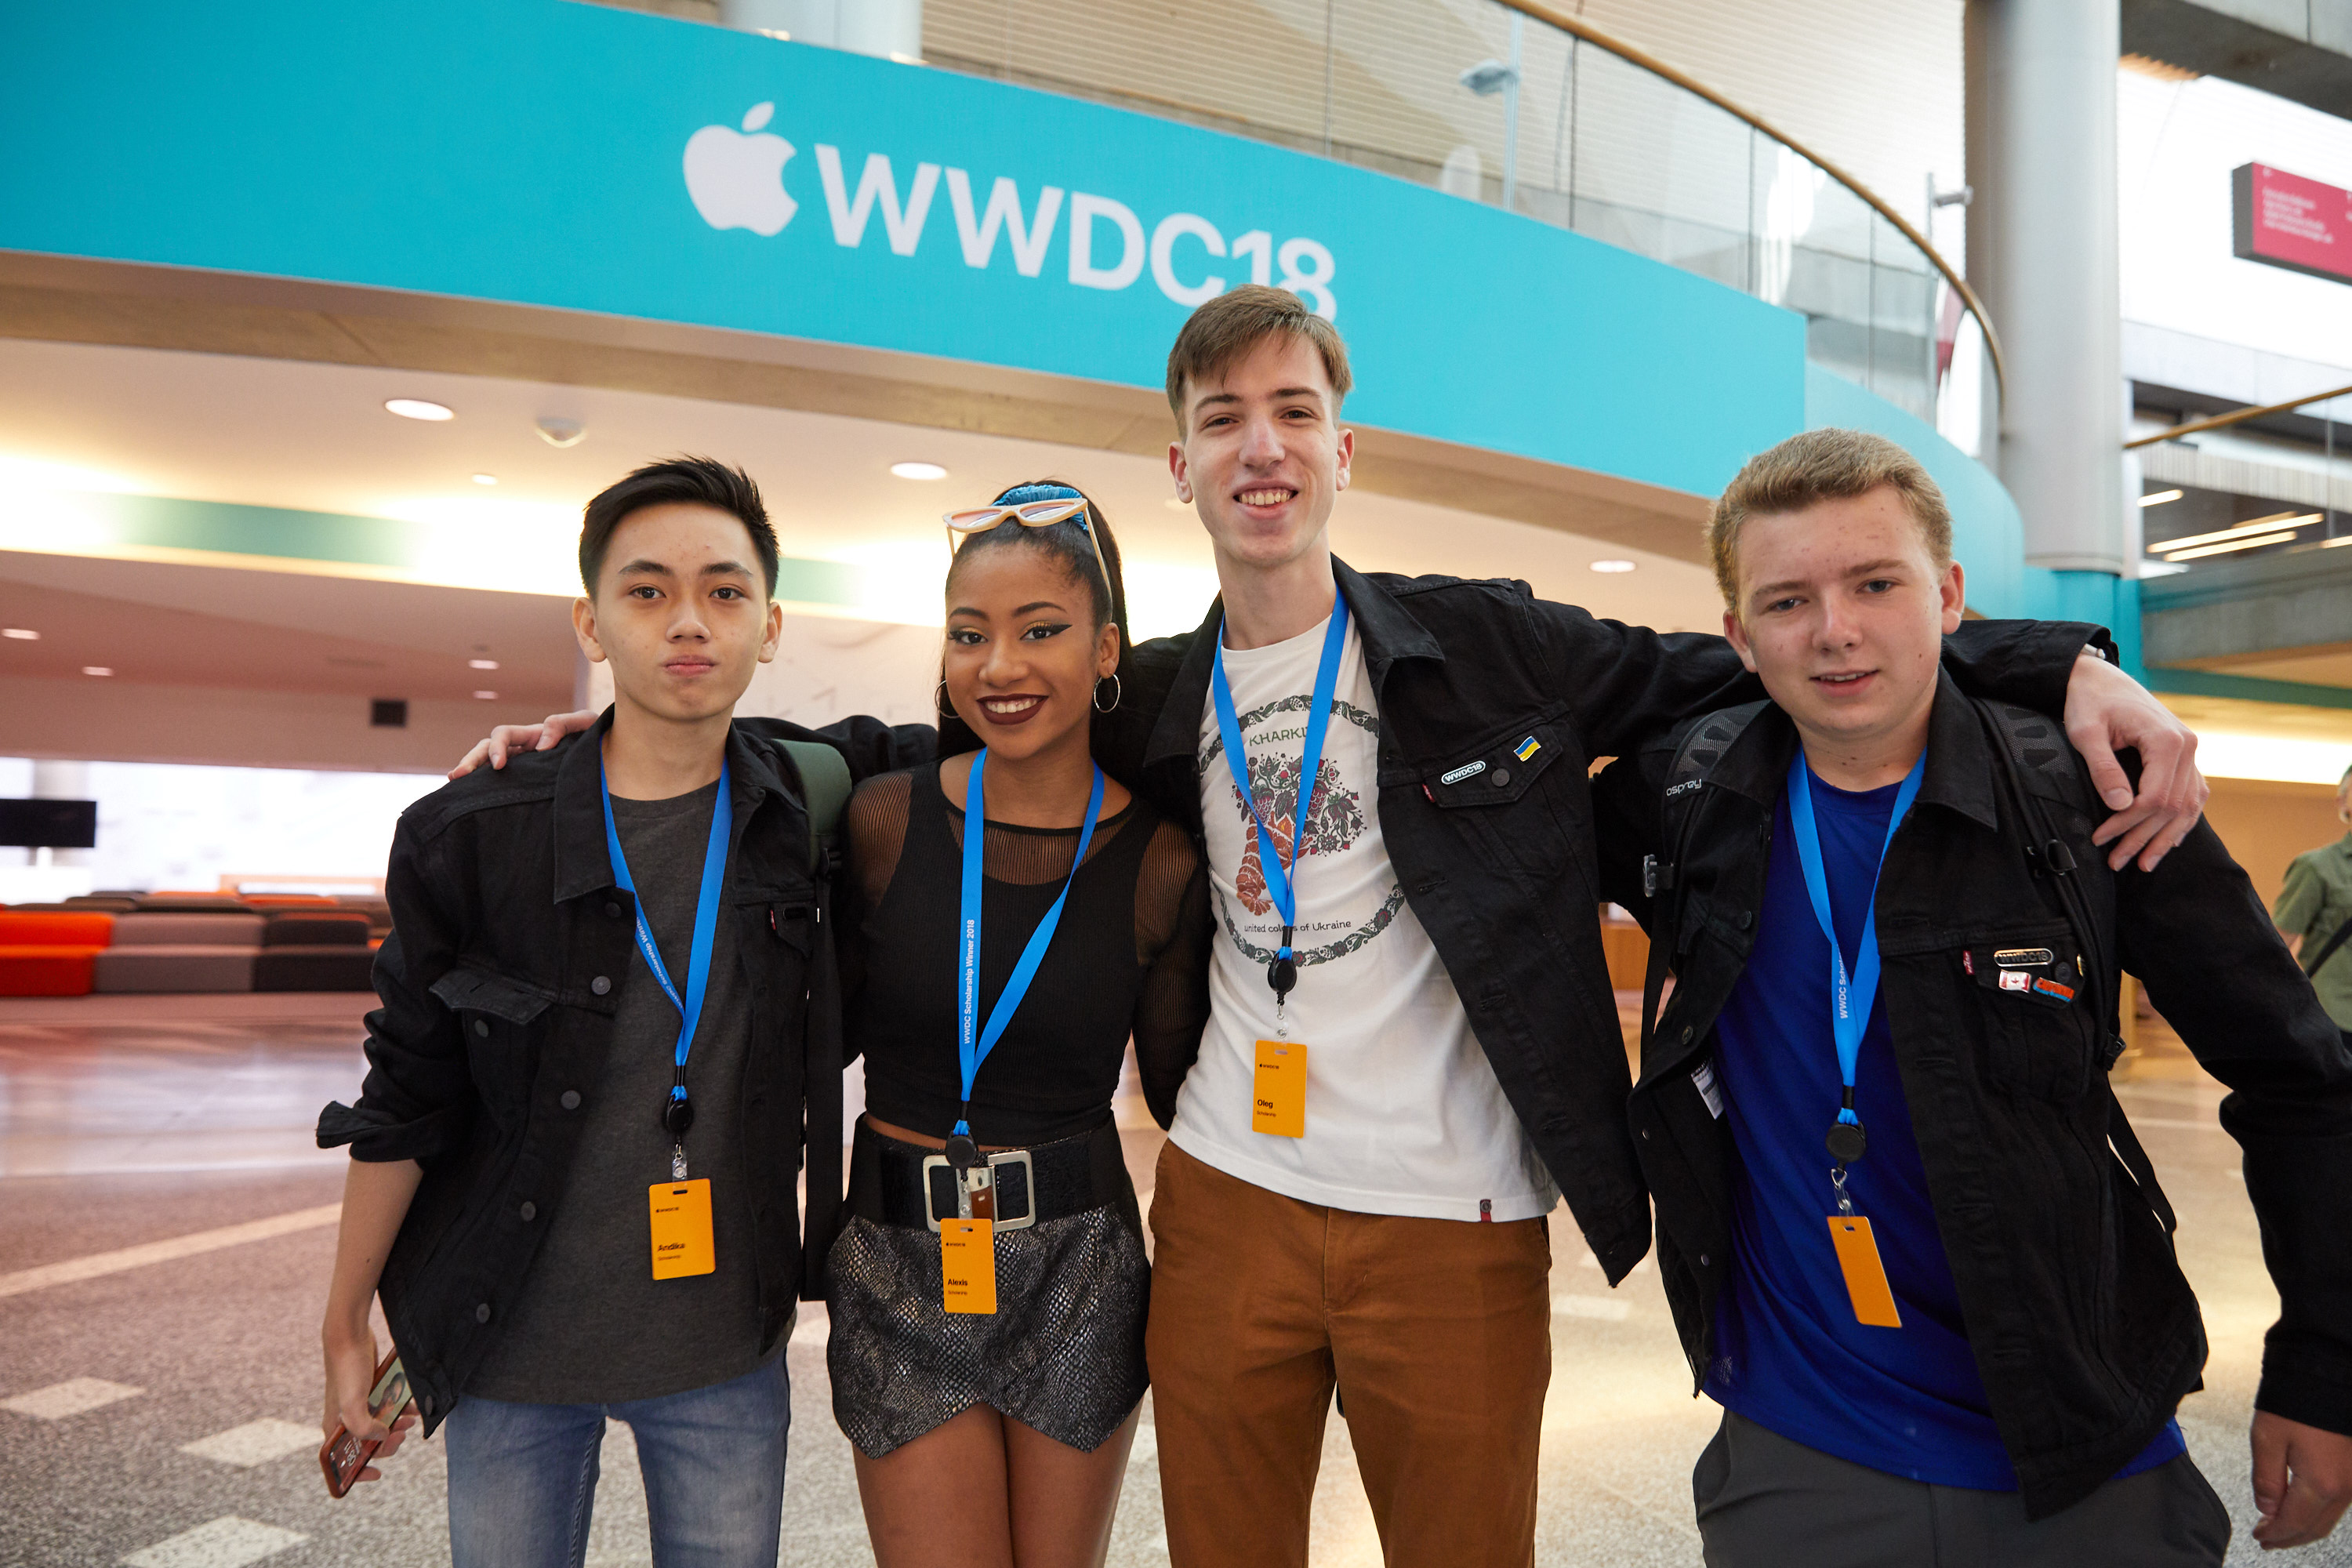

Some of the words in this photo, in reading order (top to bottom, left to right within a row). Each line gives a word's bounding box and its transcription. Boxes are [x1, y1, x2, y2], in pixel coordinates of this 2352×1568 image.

[814, 143, 1338, 323] WWDC18
[1249, 726, 1308, 746] KHARKI
[1445, 763, 1483, 782] WWDC18
[1666, 778, 1702, 797] osprey
[967, 919, 975, 938] 2018
[1244, 924, 1266, 933] united
[1268, 924, 1298, 933] cols
[1300, 923, 1310, 931] of
[1312, 920, 1352, 931] Ukraine
[965, 939, 975, 967] Winner
[1999, 951, 2049, 964] WWDC18
[645, 942, 668, 985] Scholarship
[964, 968, 975, 1015] Scholarship
[1838, 986, 1849, 1019] WWDC
[1257, 1098, 1274, 1109] Oleg
[947, 1278, 968, 1287] Alexis
